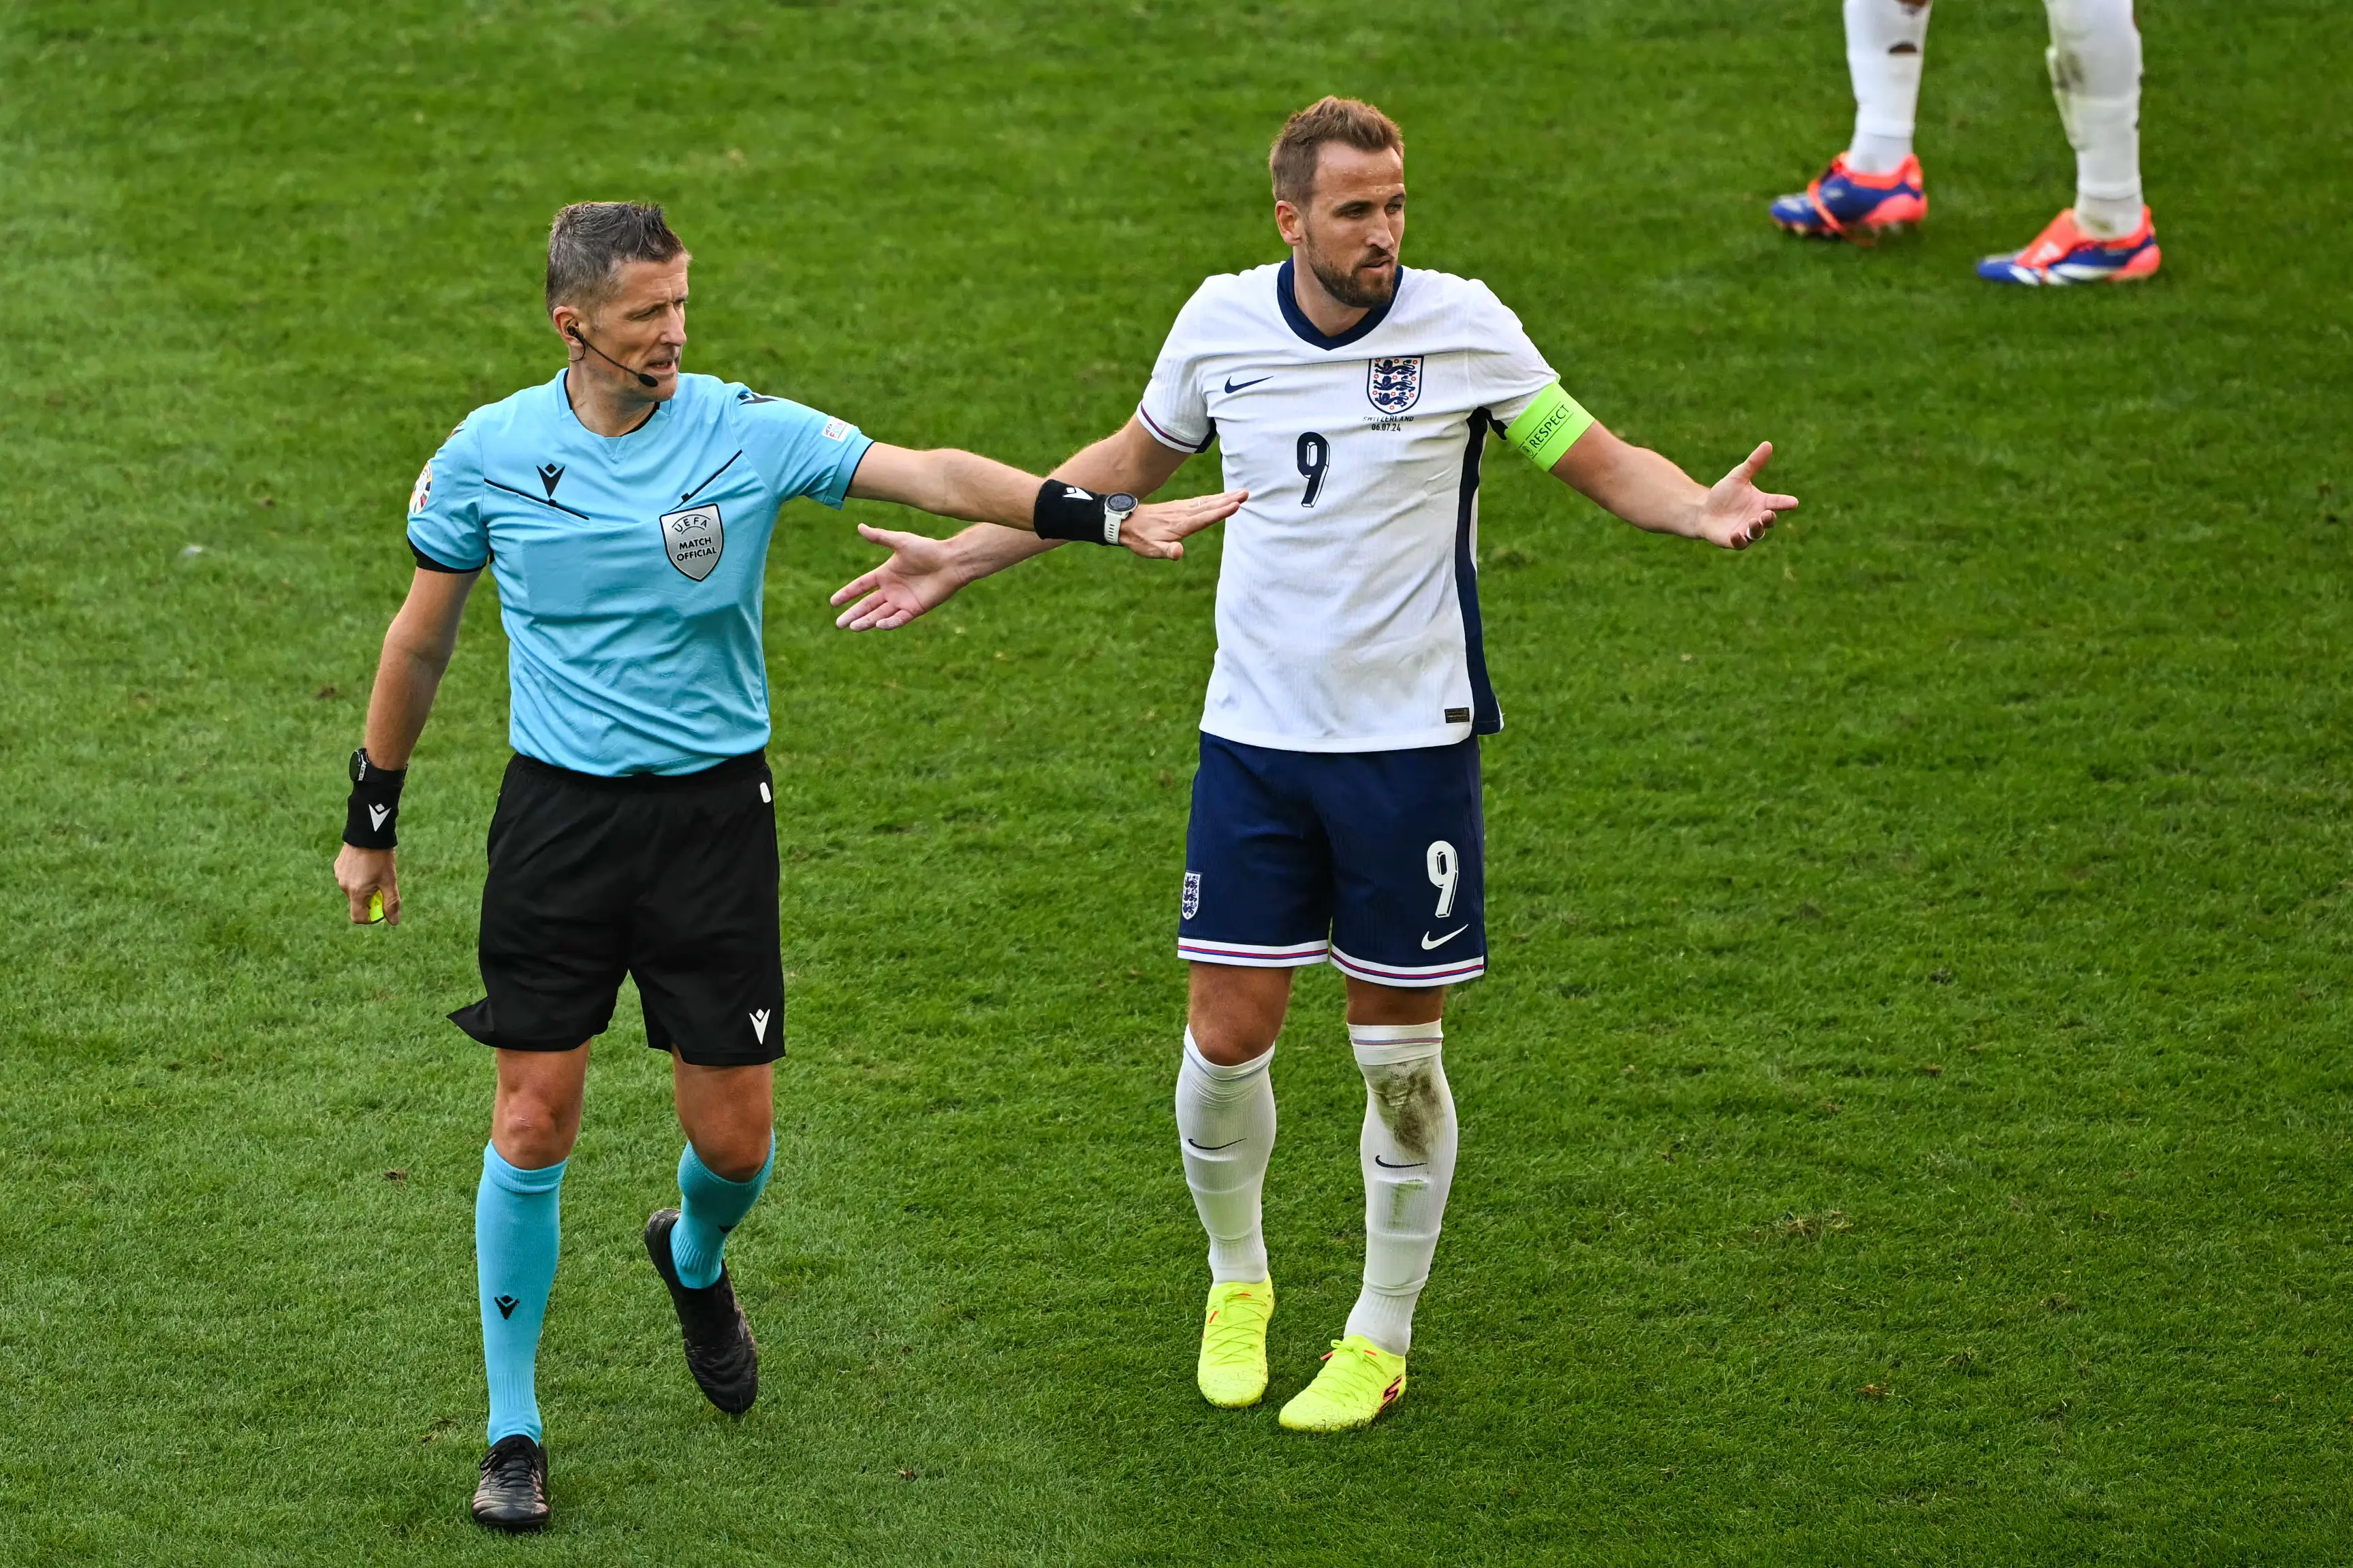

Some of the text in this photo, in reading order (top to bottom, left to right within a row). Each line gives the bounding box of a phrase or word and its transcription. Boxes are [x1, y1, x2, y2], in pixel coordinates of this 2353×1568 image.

[1372, 423, 1401, 432] 06.07.24
[1529, 404, 1569, 449] RESPECT
[1297, 432, 1330, 508] 9
[674, 517, 707, 532] UEFA
[679, 537, 712, 550] MATCH
[676, 547, 717, 561] OFFICIAL
[1427, 840, 1459, 918] 9
